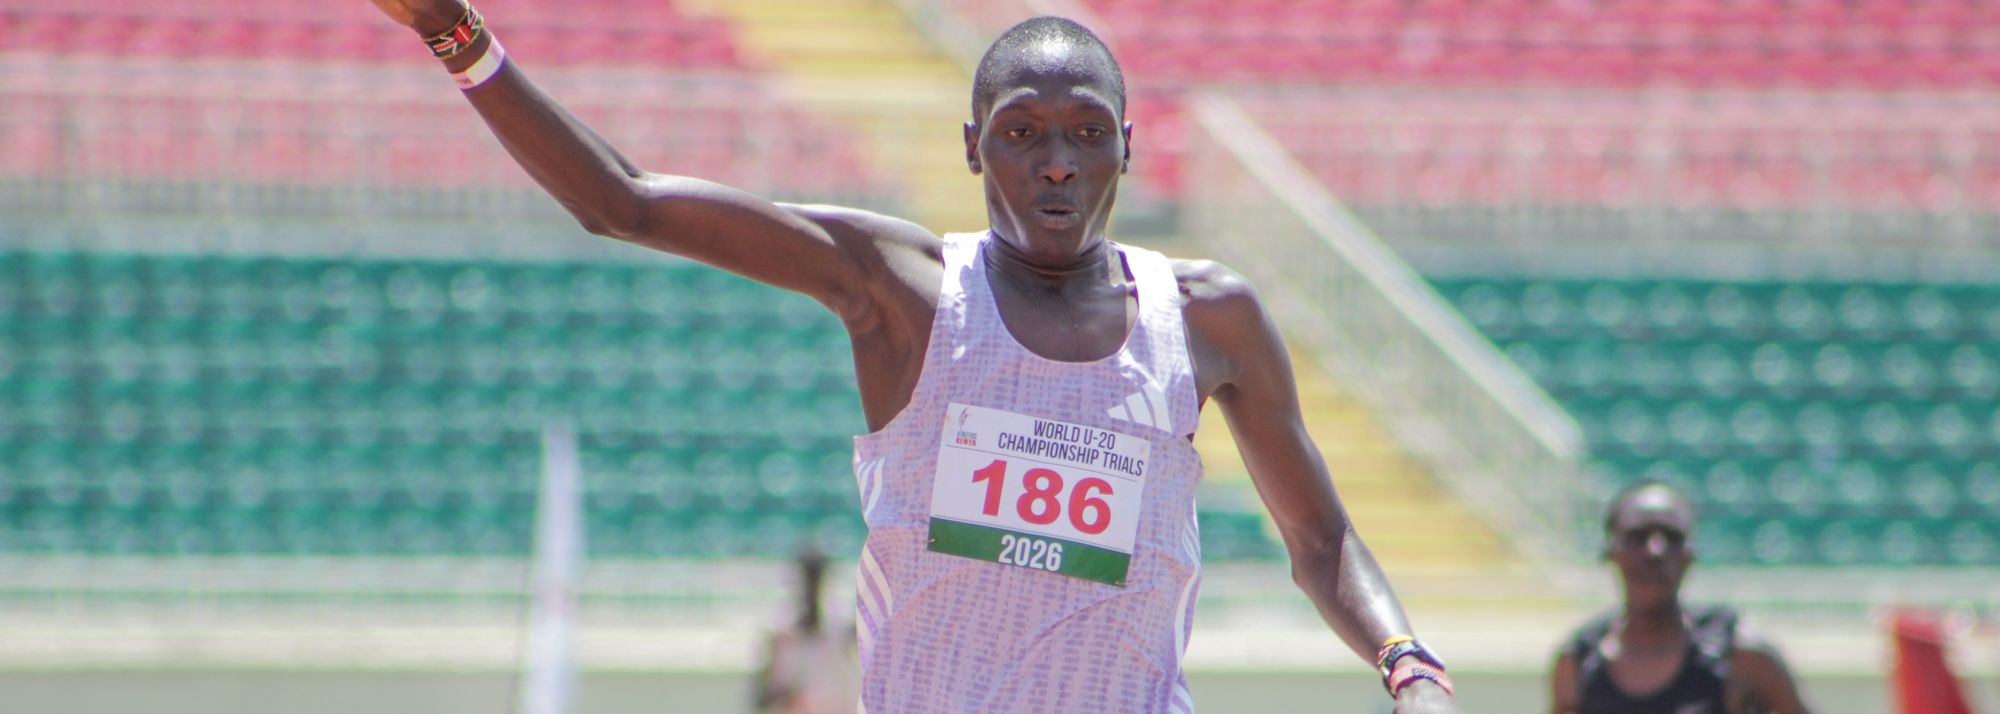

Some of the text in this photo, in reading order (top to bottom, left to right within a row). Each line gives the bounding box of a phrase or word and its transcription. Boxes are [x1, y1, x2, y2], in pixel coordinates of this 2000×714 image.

[998, 432, 1144, 477] CHAMPIONSHIP TRIALS
[1034, 420, 1116, 450] WORLD U-20
[972, 459, 1114, 535] 186
[998, 534, 1063, 572] 2026
